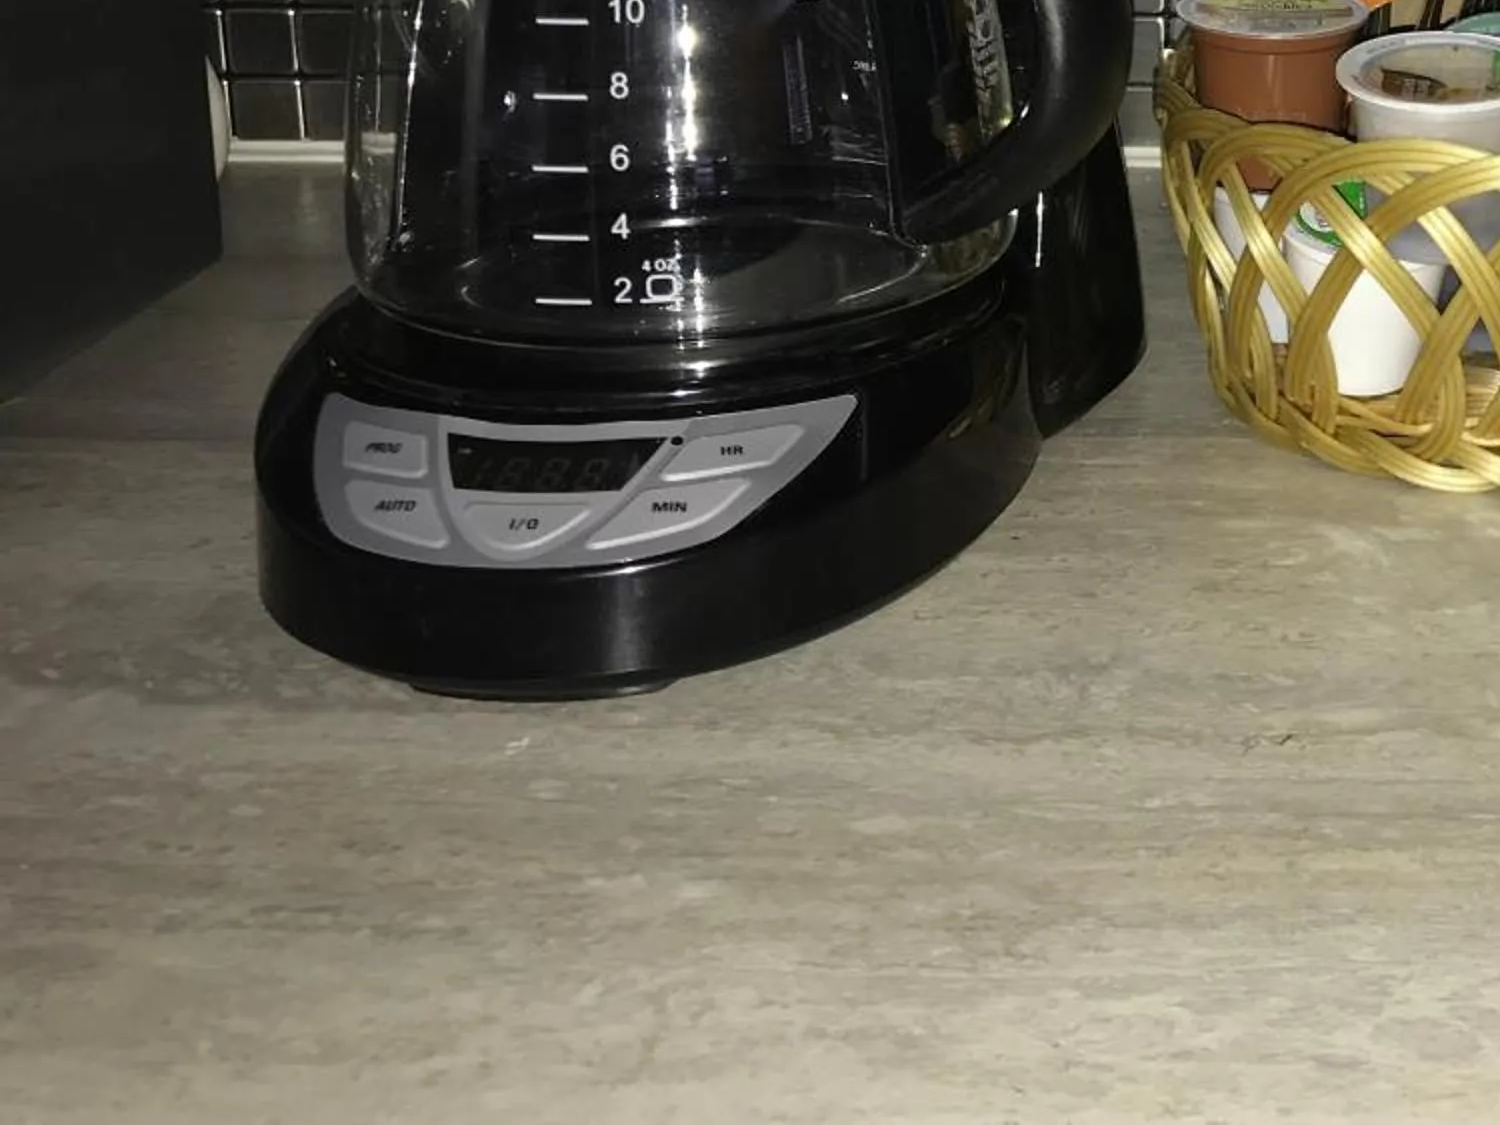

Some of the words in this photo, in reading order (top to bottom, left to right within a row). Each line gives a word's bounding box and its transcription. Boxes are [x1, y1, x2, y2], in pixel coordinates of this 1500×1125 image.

[609, 72, 629, 100] 8
[609, 144, 630, 172] 6
[610, 213, 631, 240] 4
[613, 276, 633, 303] 2
[720, 443, 745, 457] HR
[374, 498, 417, 514] AUTO
[652, 500, 688, 514] MIN
